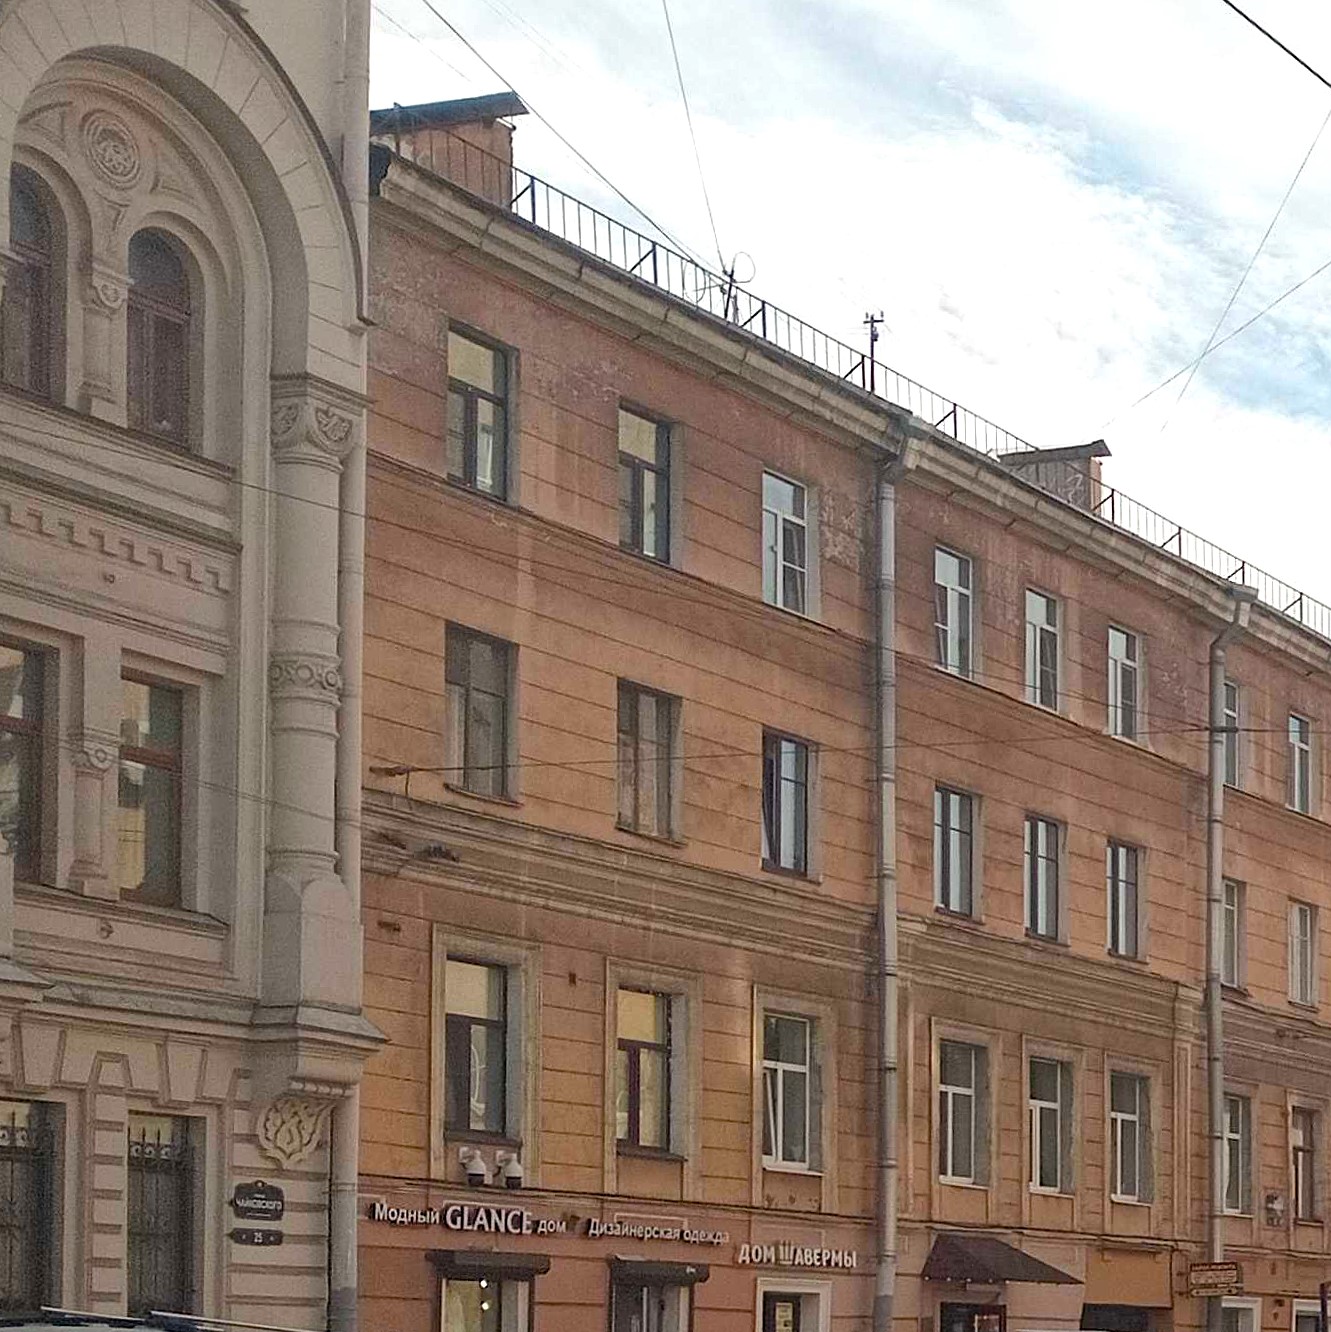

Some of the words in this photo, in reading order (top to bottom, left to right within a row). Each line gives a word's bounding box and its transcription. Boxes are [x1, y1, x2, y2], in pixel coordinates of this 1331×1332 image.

[374, 1202, 440, 1225] Модный
[446, 1205, 533, 1235] GLANCE
[537, 1220, 567, 1235] дом
[588, 1218, 681, 1241] Дизайнерская
[683, 1228, 730, 1245] одежда
[738, 1243, 775, 1265] ДОМ
[778, 1240, 857, 1269] ШАВЕРМЫ
